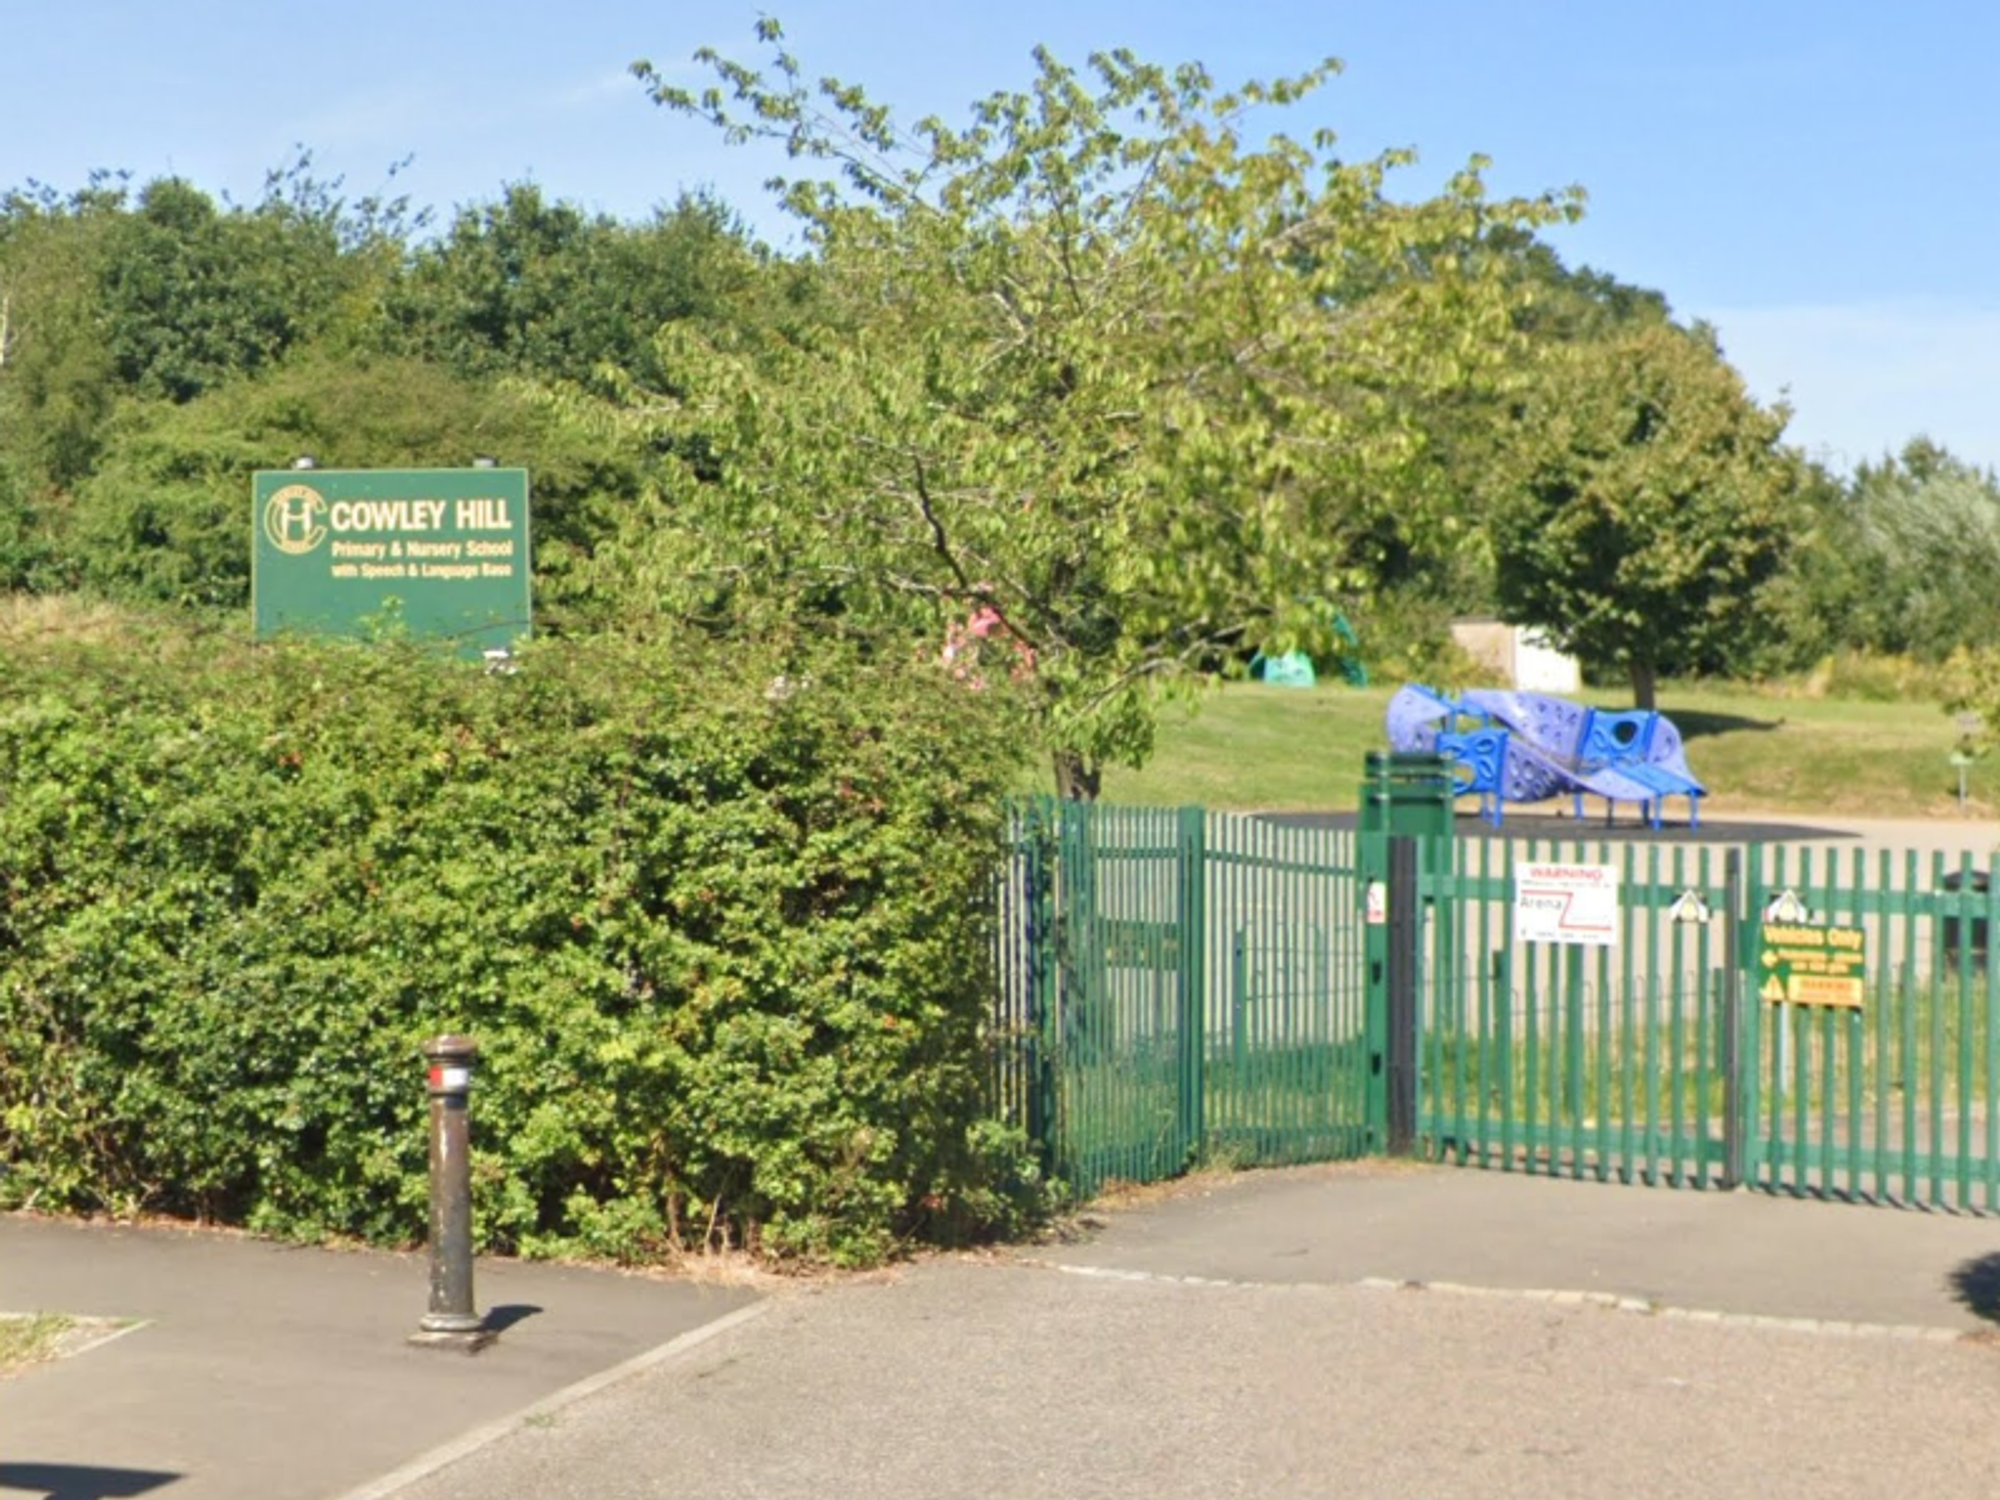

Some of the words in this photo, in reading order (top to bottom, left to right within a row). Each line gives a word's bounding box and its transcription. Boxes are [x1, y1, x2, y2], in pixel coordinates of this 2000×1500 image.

[331, 501, 446, 531] COWLEY
[456, 499, 513, 530] HILL
[331, 541, 386, 560] Primary
[391, 541, 403, 557] &
[406, 541, 461, 560] Nursery
[466, 540, 513, 557] School
[1530, 867, 1604, 882] WARNING
[1520, 896, 1561, 910] Arena
[1827, 927, 1862, 951] Only
